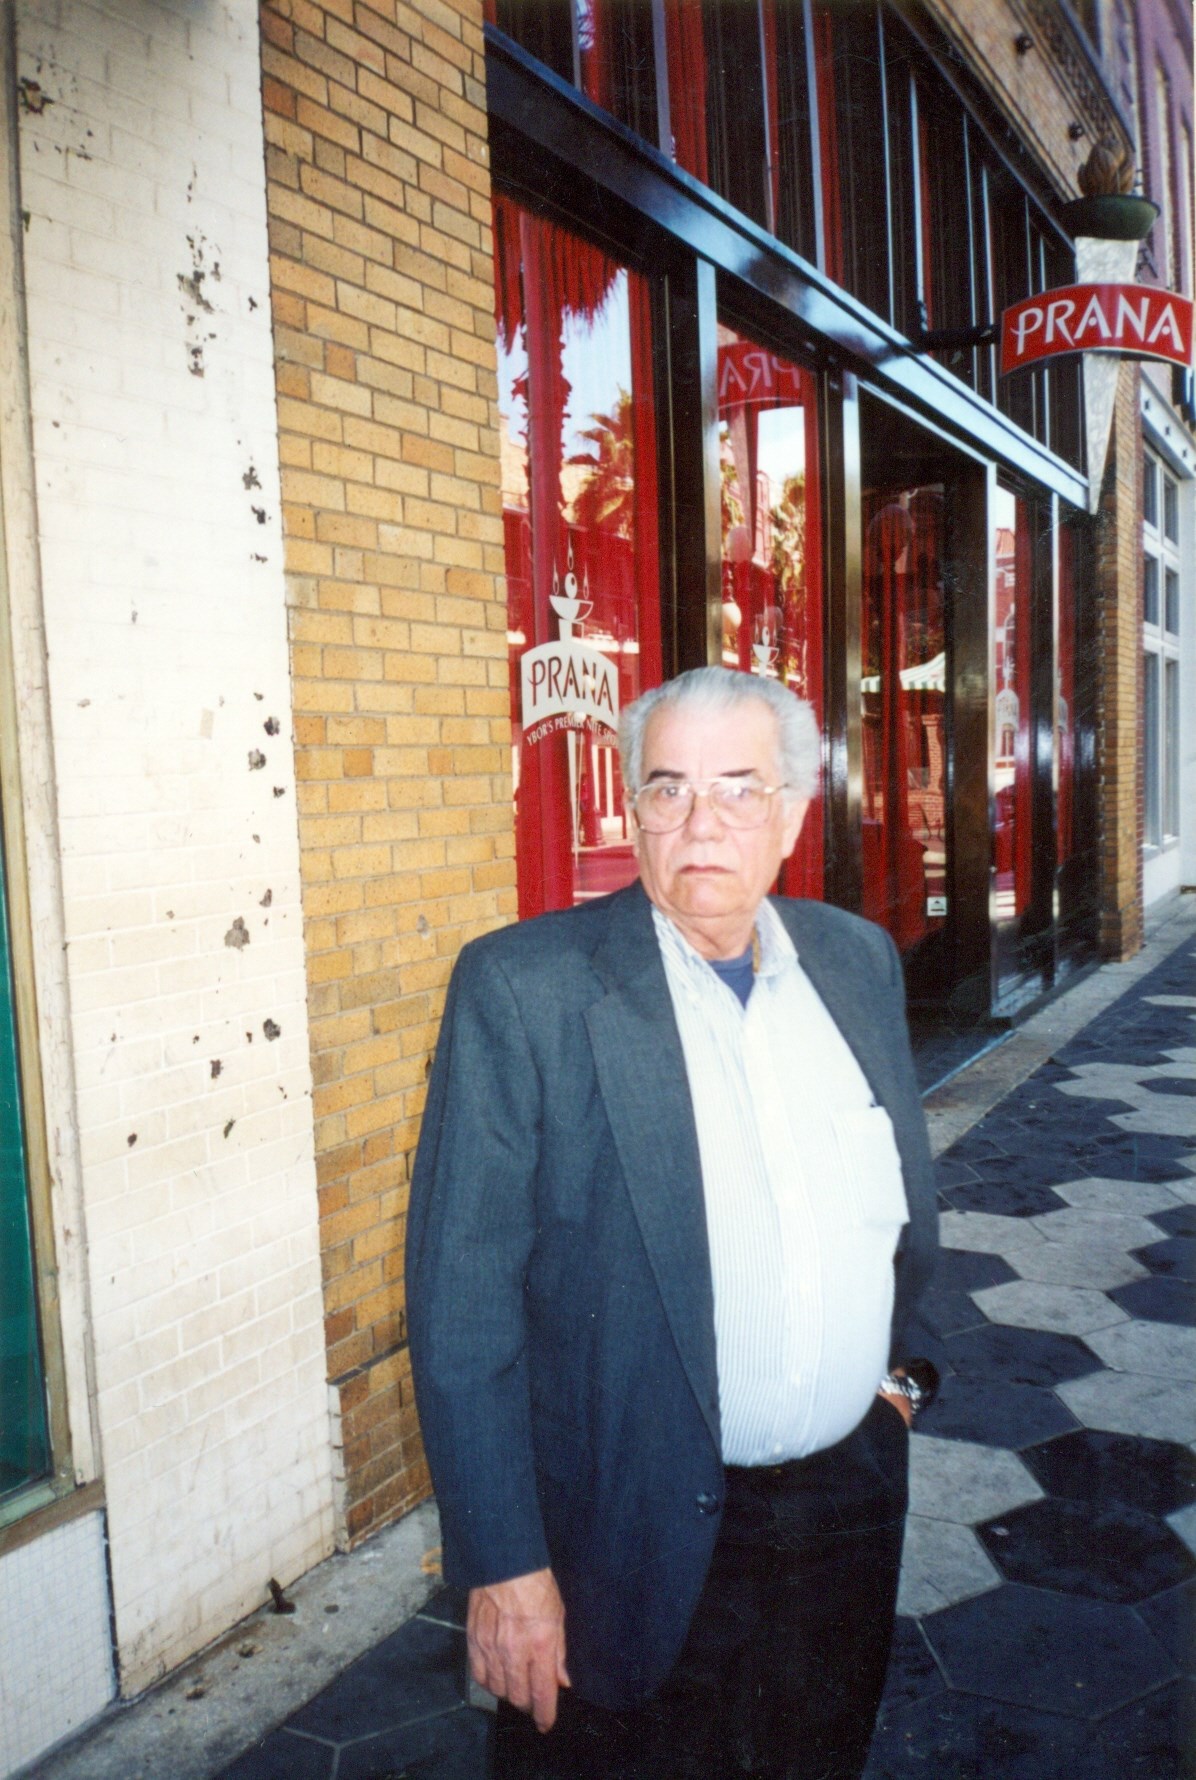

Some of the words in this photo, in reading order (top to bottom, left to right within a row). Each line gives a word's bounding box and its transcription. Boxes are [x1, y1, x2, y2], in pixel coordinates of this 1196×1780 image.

[1010, 293, 1185, 356] PRANA
[527, 655, 614, 716] PRANA
[526, 721, 554, 746] YBOR'S
